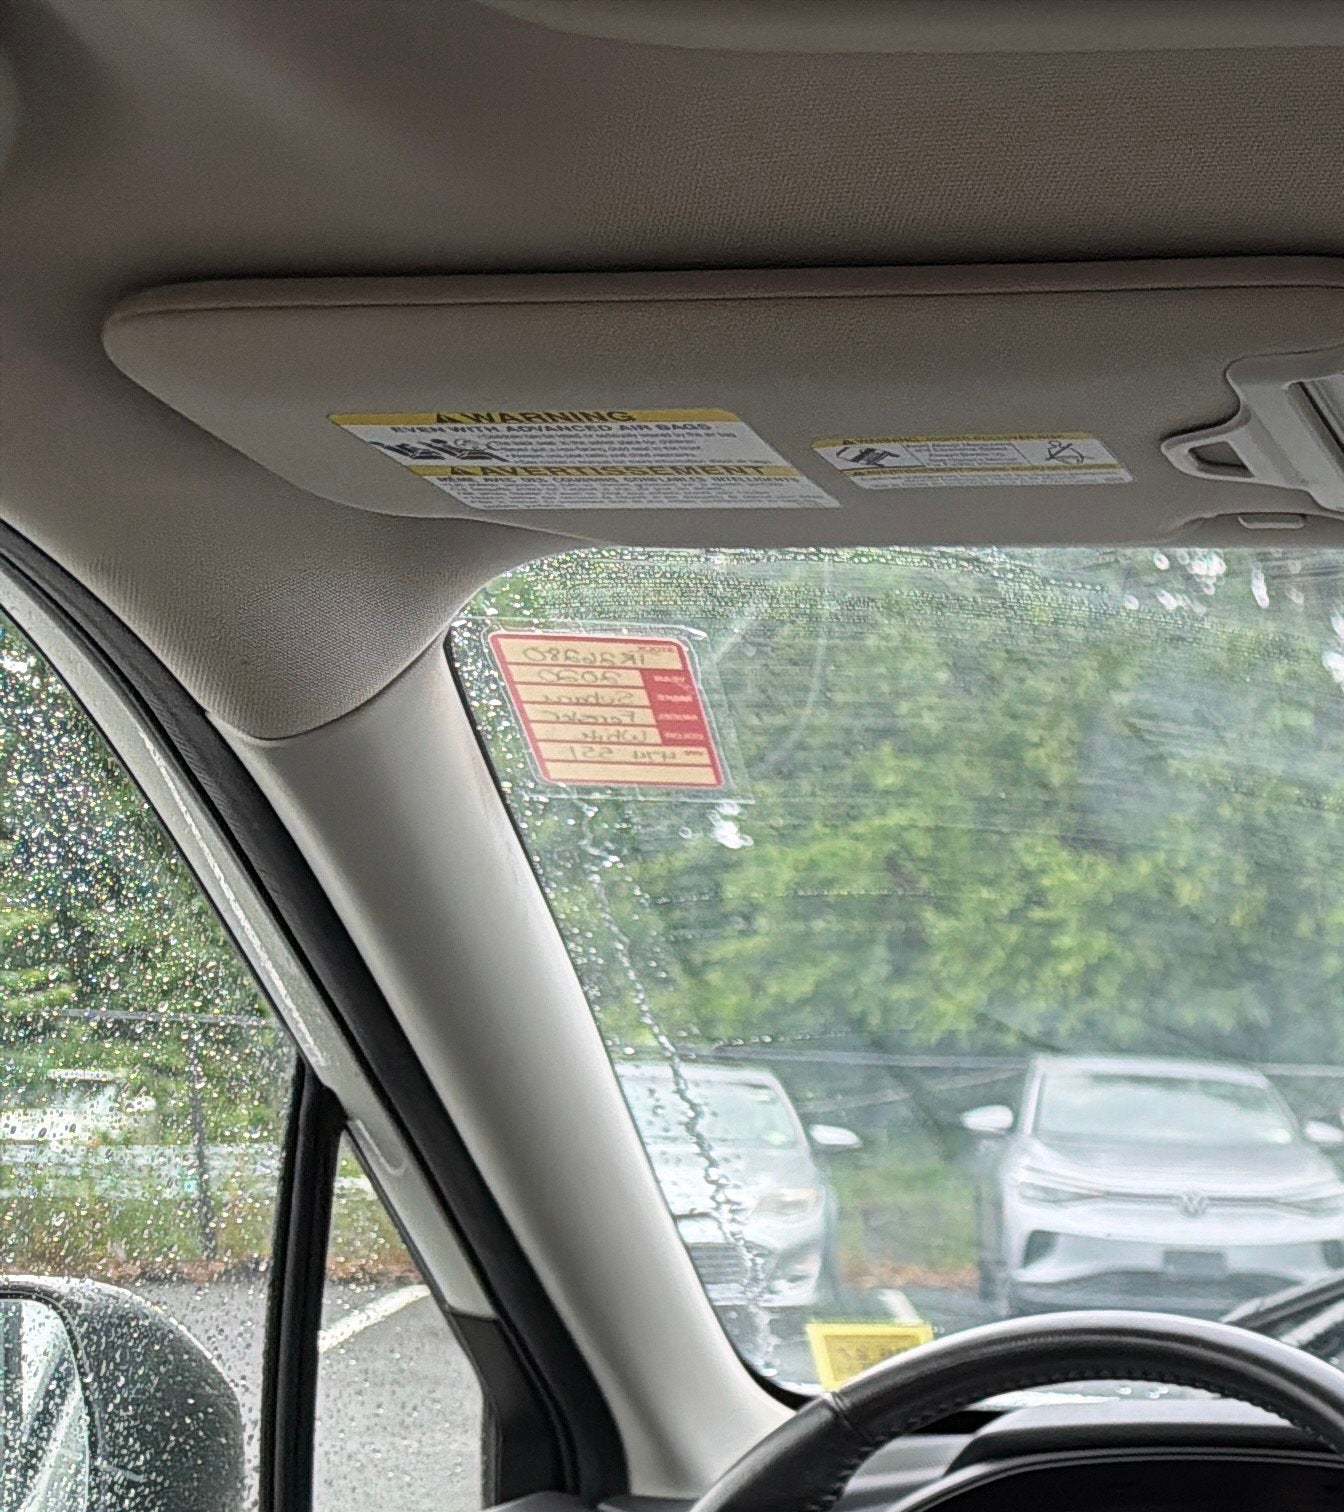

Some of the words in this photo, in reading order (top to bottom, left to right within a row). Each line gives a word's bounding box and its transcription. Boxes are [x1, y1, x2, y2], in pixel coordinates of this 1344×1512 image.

[460, 411, 636, 424] WARNING
[391, 426, 446, 434] EVEN
[447, 425, 499, 433] WITH
[505, 424, 613, 433] ADVANCED
[619, 423, 649, 432] AIR
[654, 422, 713, 432] BAGS
[481, 465, 766, 477] AVERTISSEMENT
